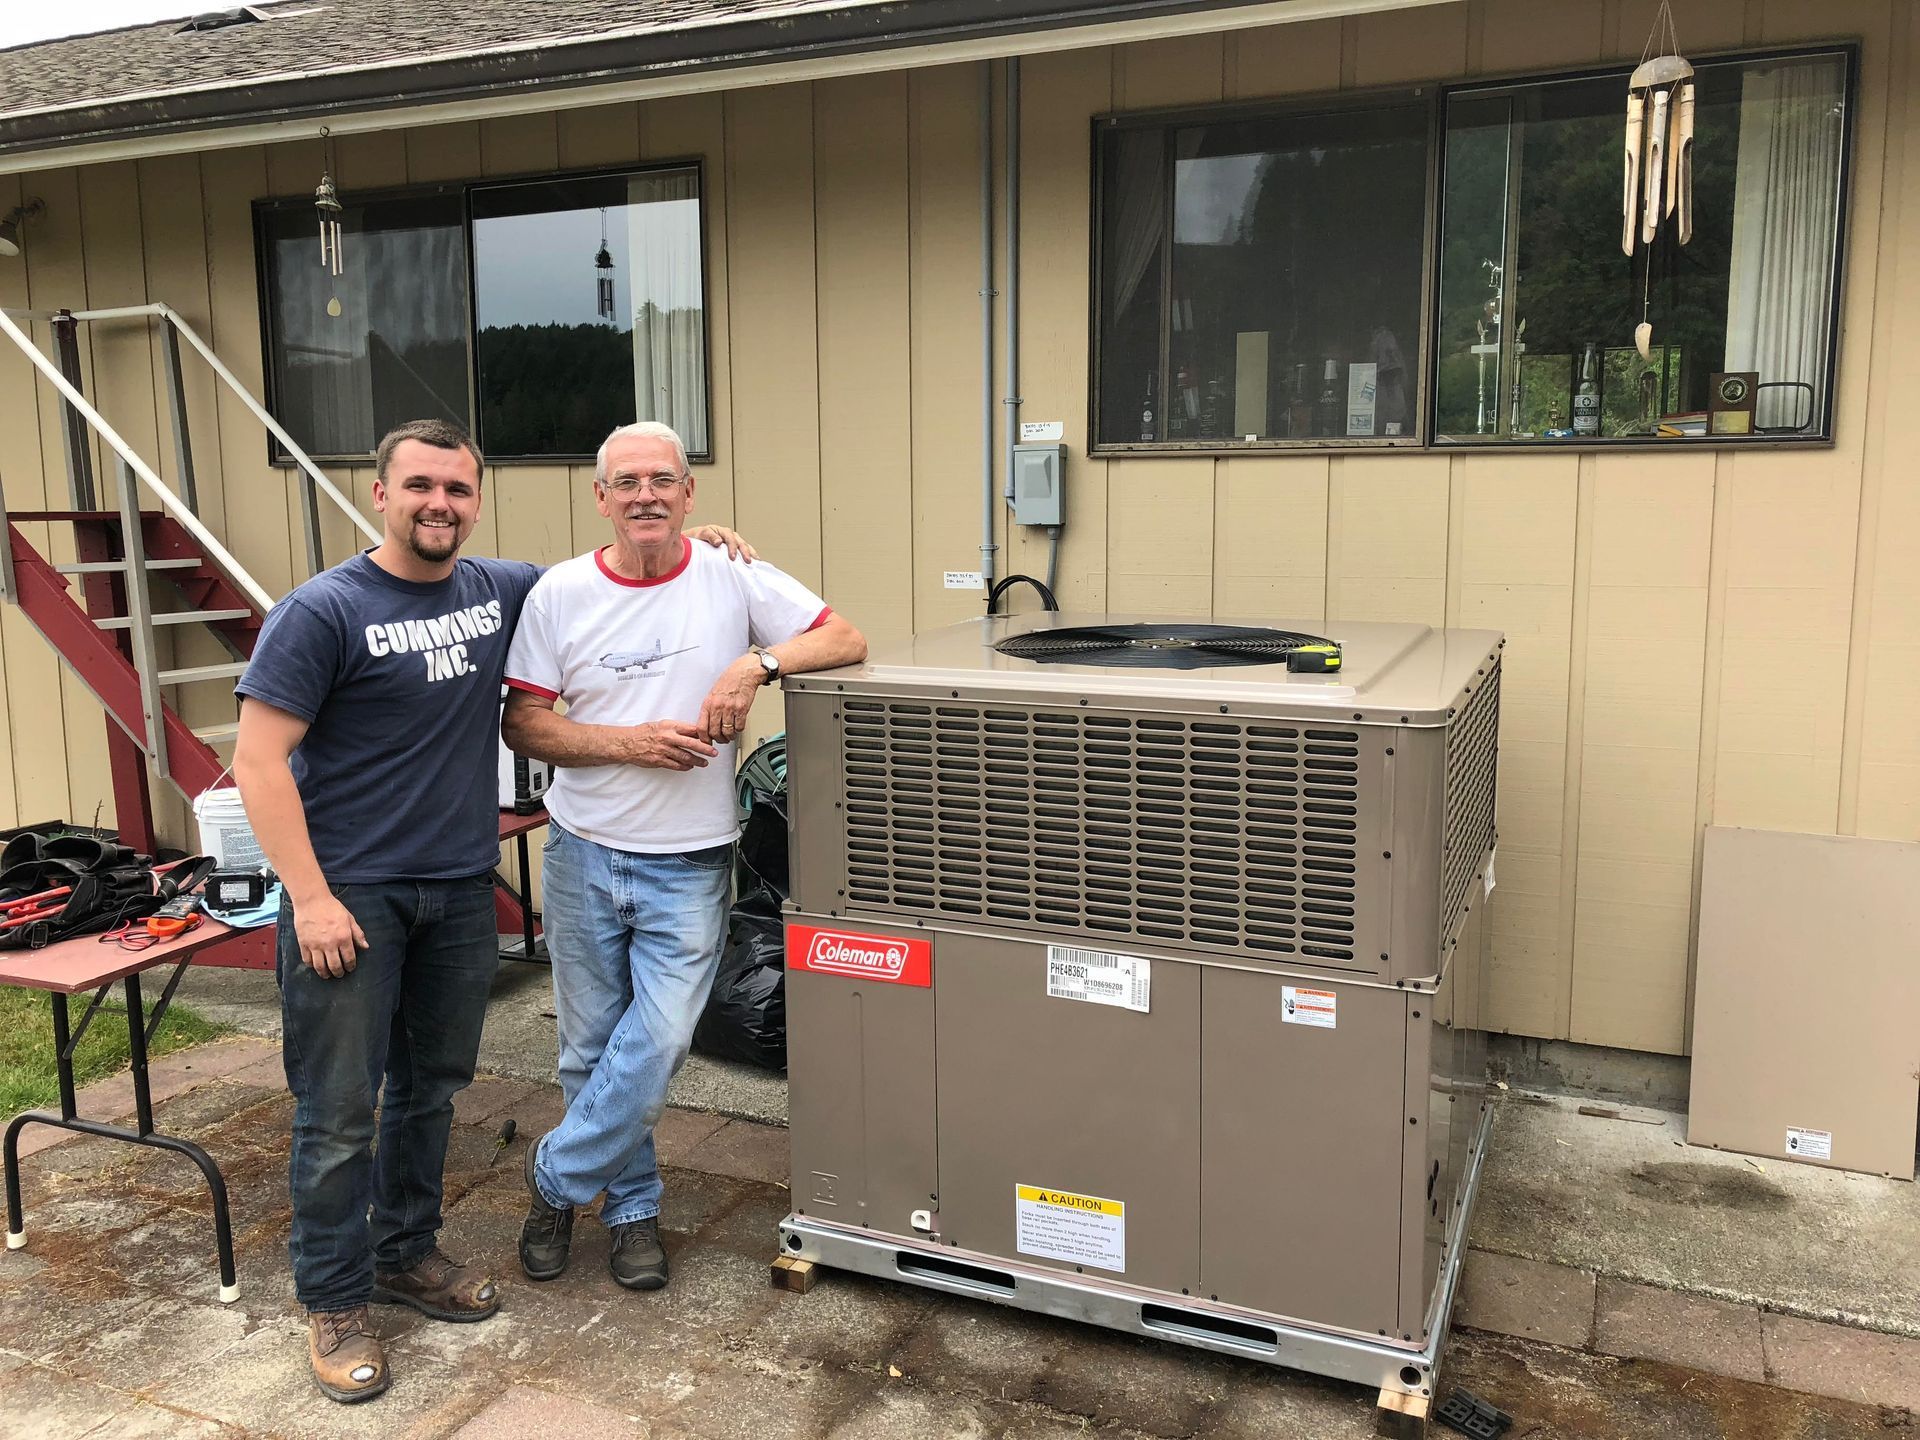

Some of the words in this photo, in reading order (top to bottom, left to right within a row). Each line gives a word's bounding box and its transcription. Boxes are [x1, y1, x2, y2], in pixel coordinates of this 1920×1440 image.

[365, 600, 502, 657] CUMMINGS
[423, 644, 477, 682] INC.
[815, 938, 885, 967] Coleman
[1050, 962, 1088, 978] PHE4B3621
[1036, 1204, 1064, 1213] HANDLING
[1064, 1209, 1103, 1219] INSTRUCTIONS
[1051, 1194, 1102, 1210] CAUTION
